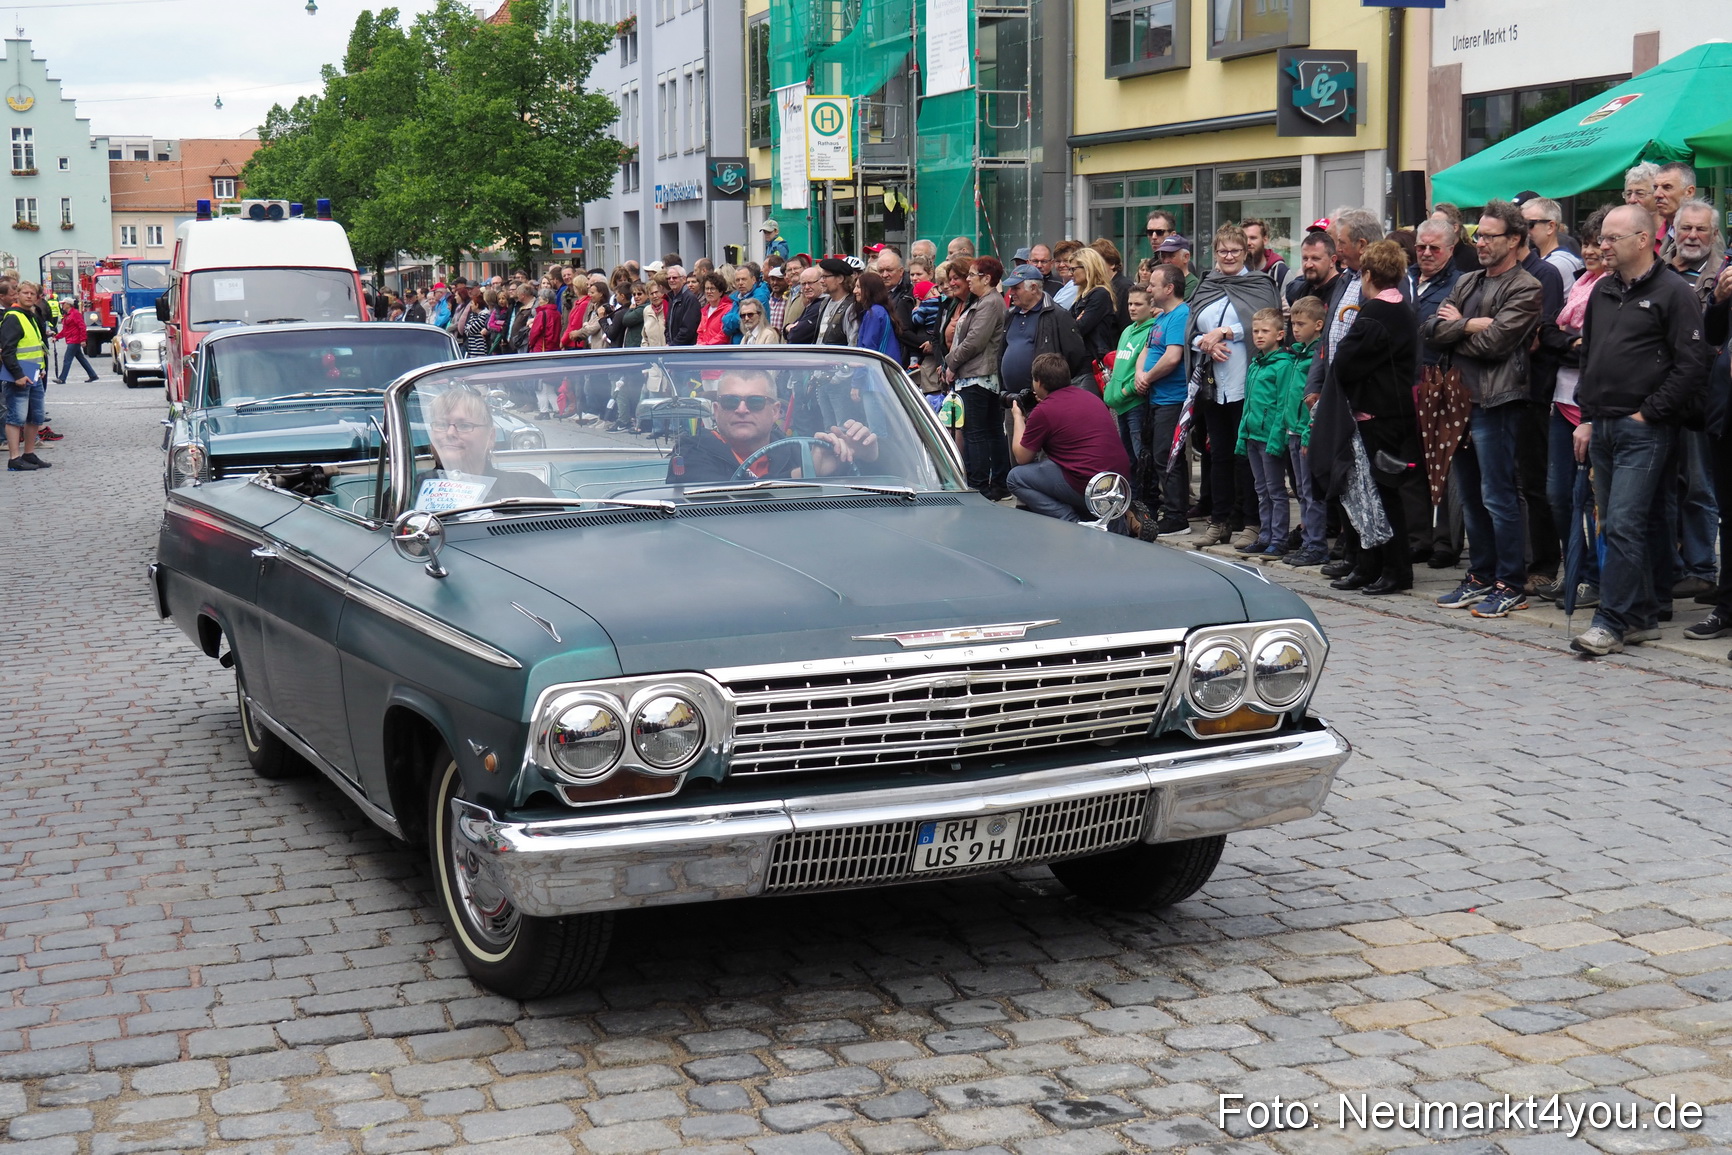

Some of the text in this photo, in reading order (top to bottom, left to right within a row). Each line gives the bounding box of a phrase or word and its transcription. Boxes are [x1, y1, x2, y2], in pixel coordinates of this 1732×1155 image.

[1452, 23, 1518, 51] Unterer Markt 15
[1310, 72, 1338, 108] G2
[820, 109, 835, 129] H
[722, 168, 738, 187] G2
[802, 636, 1113, 670] CHEVROLET
[922, 836, 930, 844] D
[942, 819, 978, 843] RH
[924, 845, 959, 868] US
